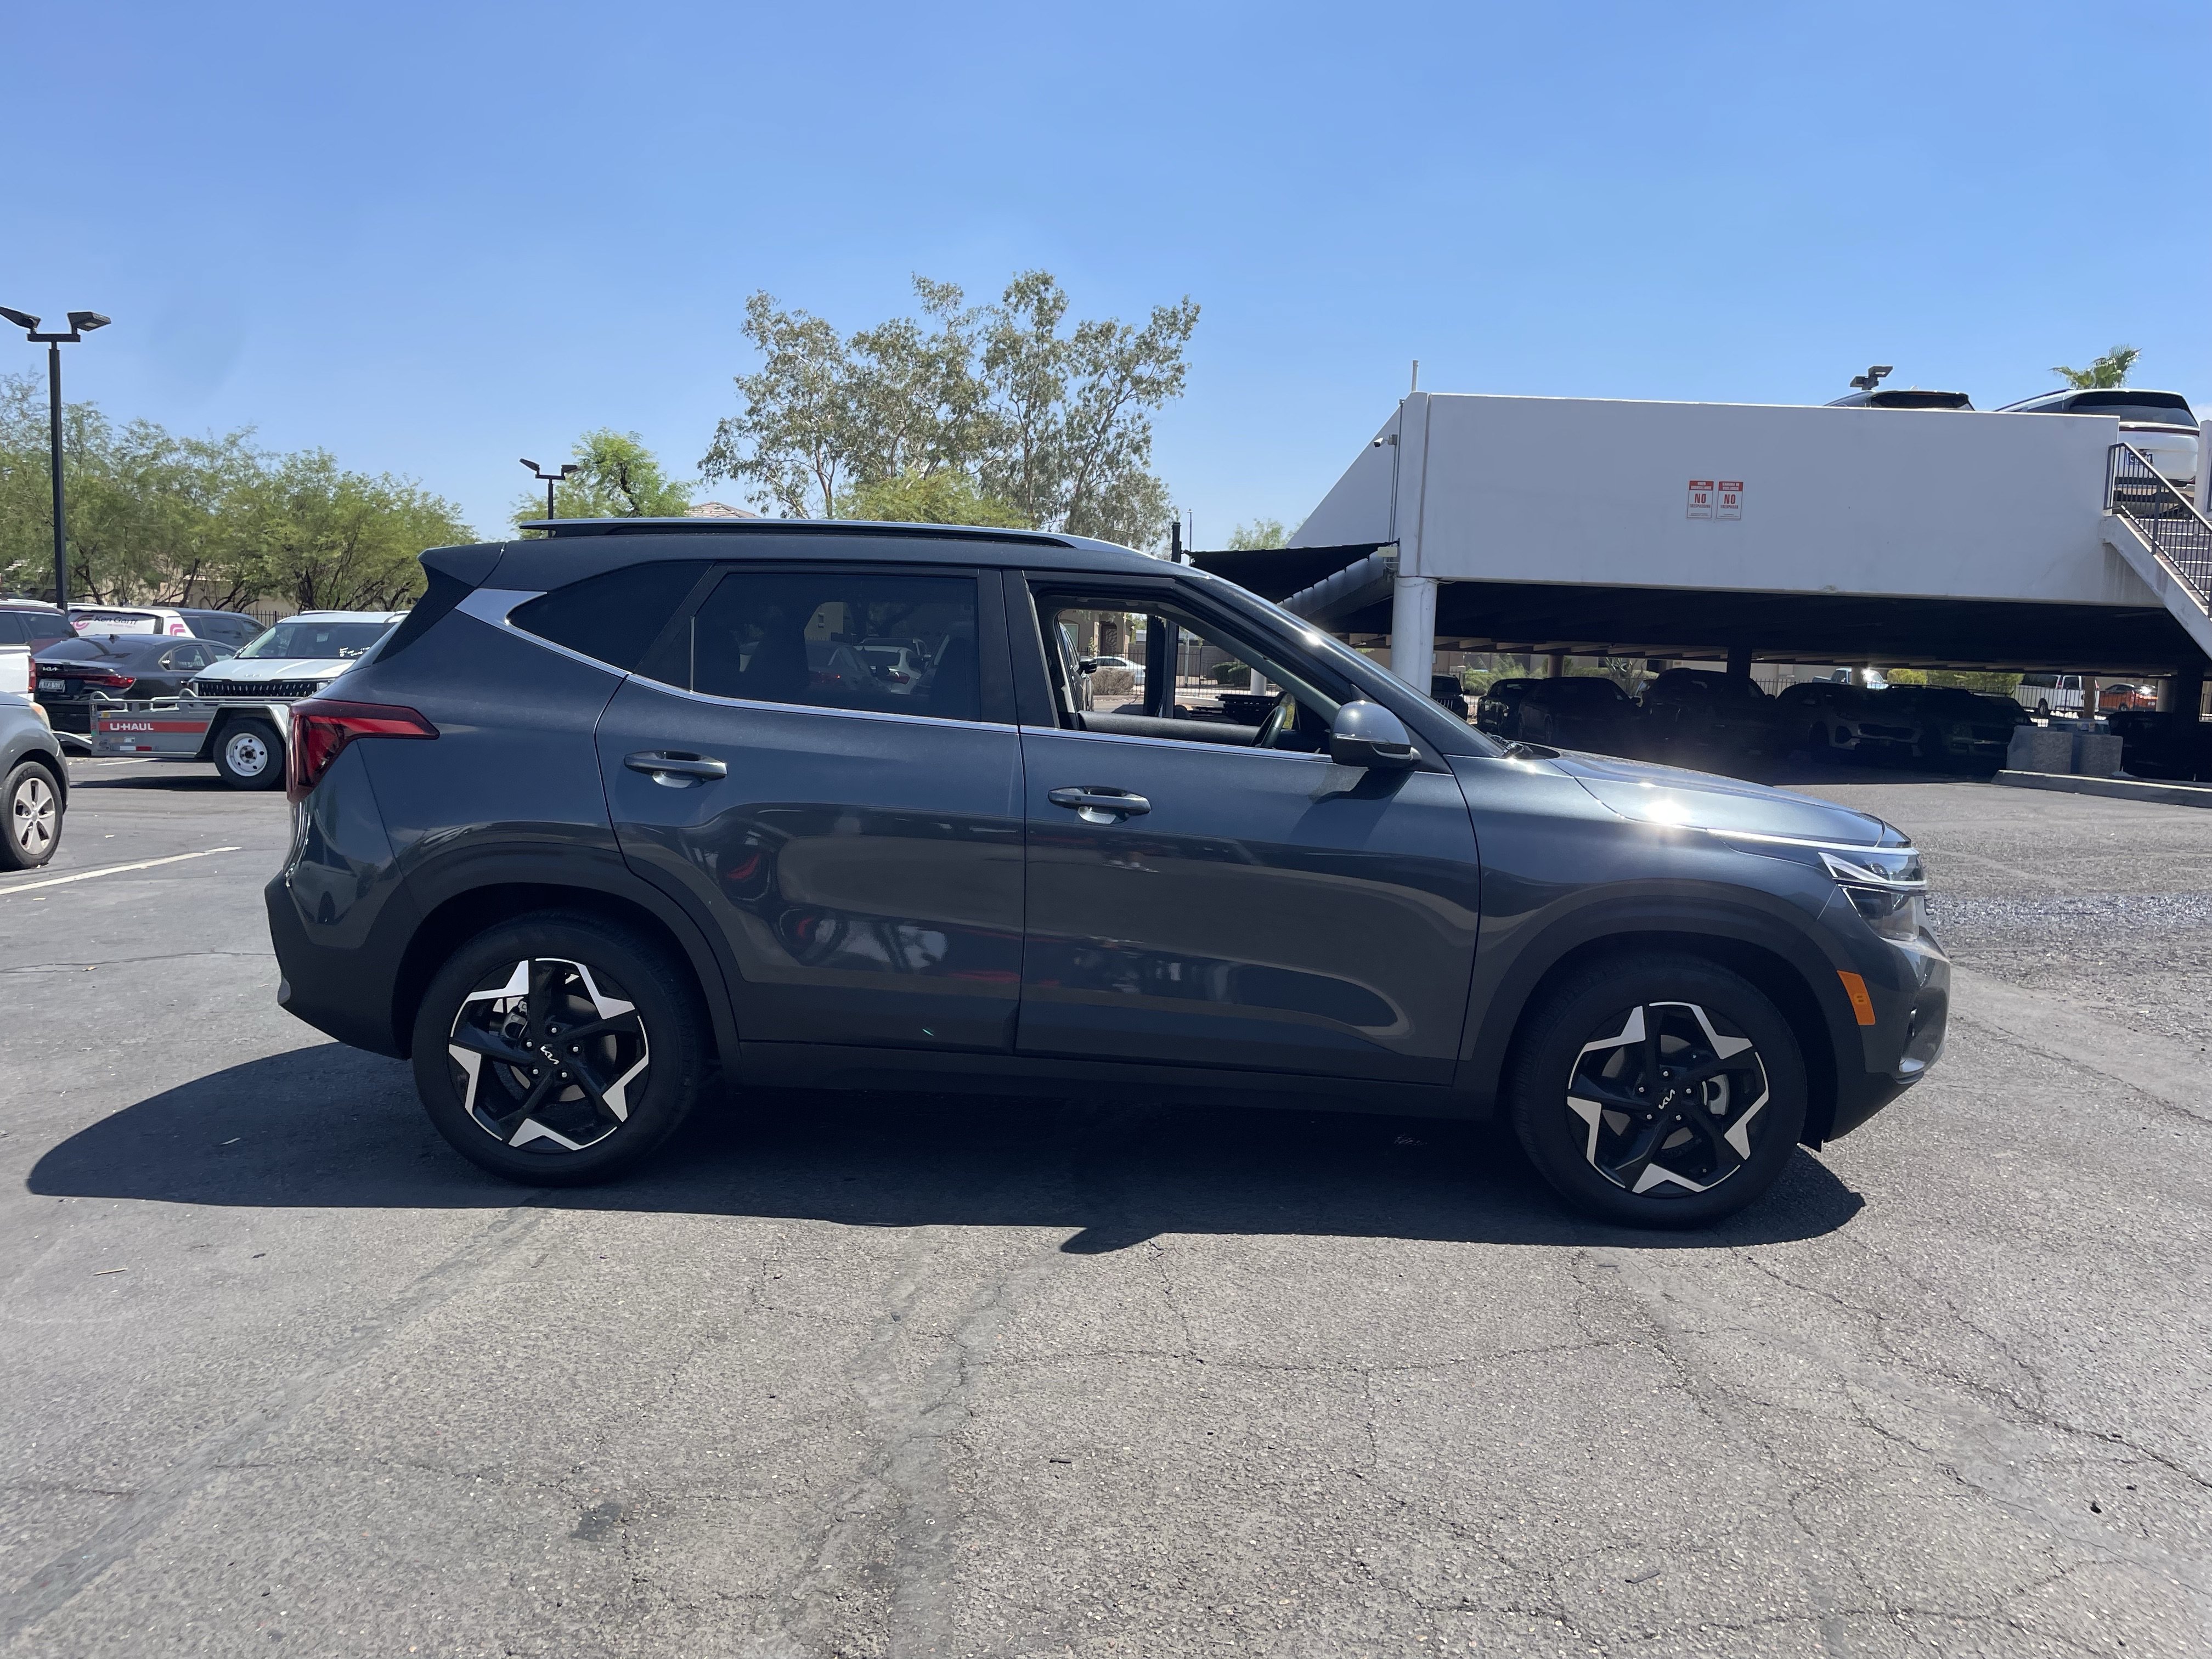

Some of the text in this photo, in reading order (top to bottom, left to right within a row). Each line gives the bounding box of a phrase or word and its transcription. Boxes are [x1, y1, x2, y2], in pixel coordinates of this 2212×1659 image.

[1695, 493, 1706, 503] NO
[1724, 494, 1736, 504] NO
[110, 723, 154, 731] U-HAUL
